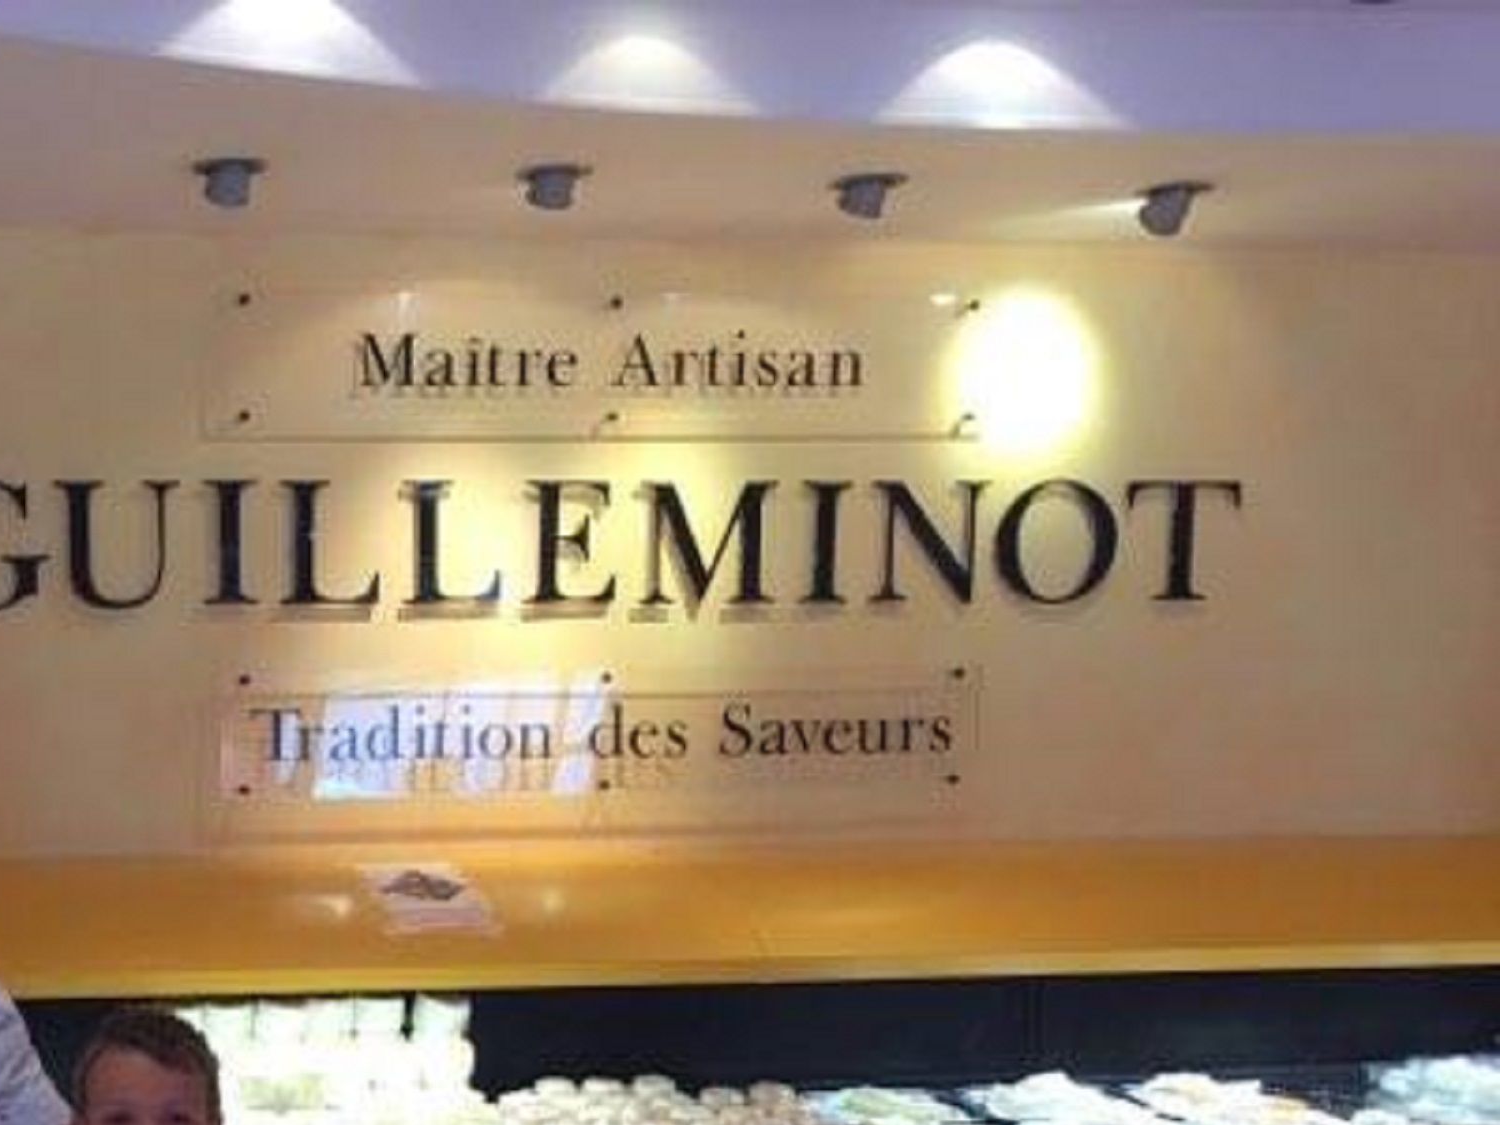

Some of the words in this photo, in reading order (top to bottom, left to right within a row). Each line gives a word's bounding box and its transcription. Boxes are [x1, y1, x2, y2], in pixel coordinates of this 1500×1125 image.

[360, 332, 579, 388] Maître
[610, 330, 865, 388] Artisan
[250, 704, 552, 763] Tradition
[589, 703, 688, 760] des
[718, 703, 953, 757] Saveurs
